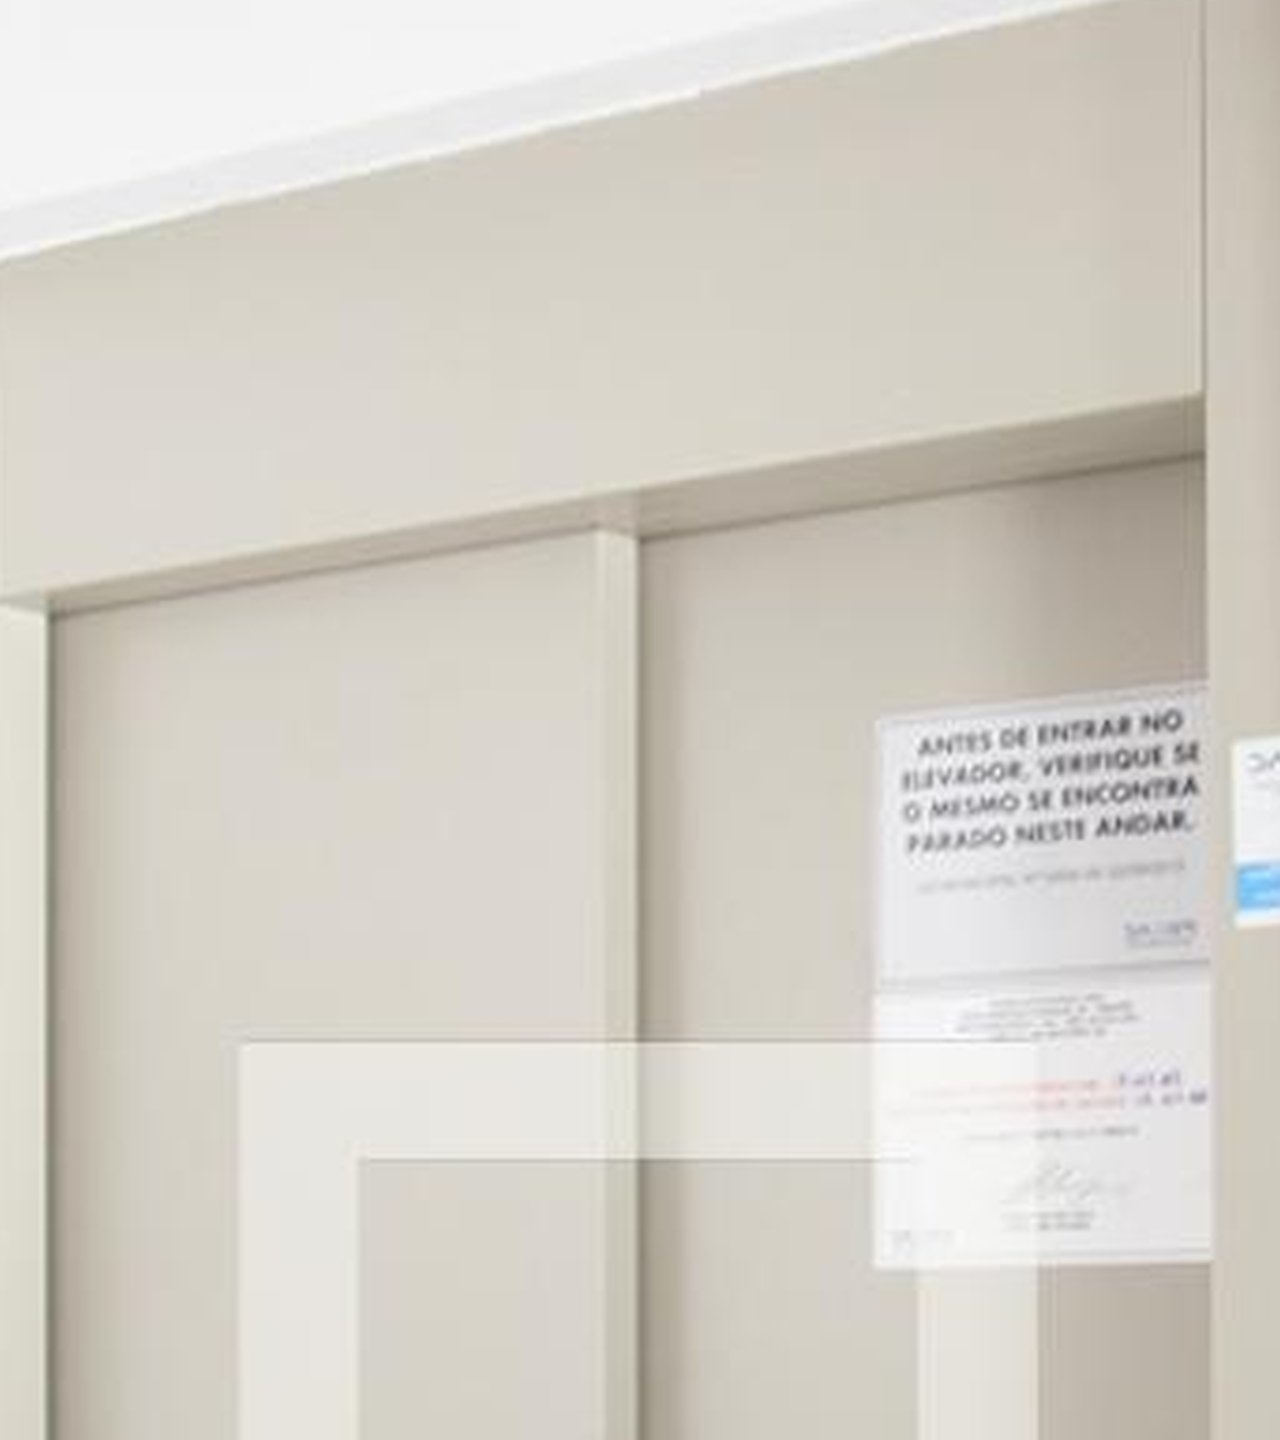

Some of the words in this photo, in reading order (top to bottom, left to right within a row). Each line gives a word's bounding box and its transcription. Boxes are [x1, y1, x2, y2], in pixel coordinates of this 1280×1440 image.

[918, 729, 992, 756] ANTES
[999, 725, 1028, 749] DE
[1037, 715, 1132, 747] ENTRAR
[1140, 708, 1183, 734] NO
[1038, 746, 1164, 777] VERIFIQUE
[1172, 741, 1200, 766] SE
[903, 802, 921, 823] O
[930, 792, 1021, 819] MESMO
[1026, 789, 1052, 811] SE
[1060, 775, 1199, 808] ENCONTRA
[907, 825, 1008, 854] PARADO
[1014, 818, 1086, 844] NESTE
